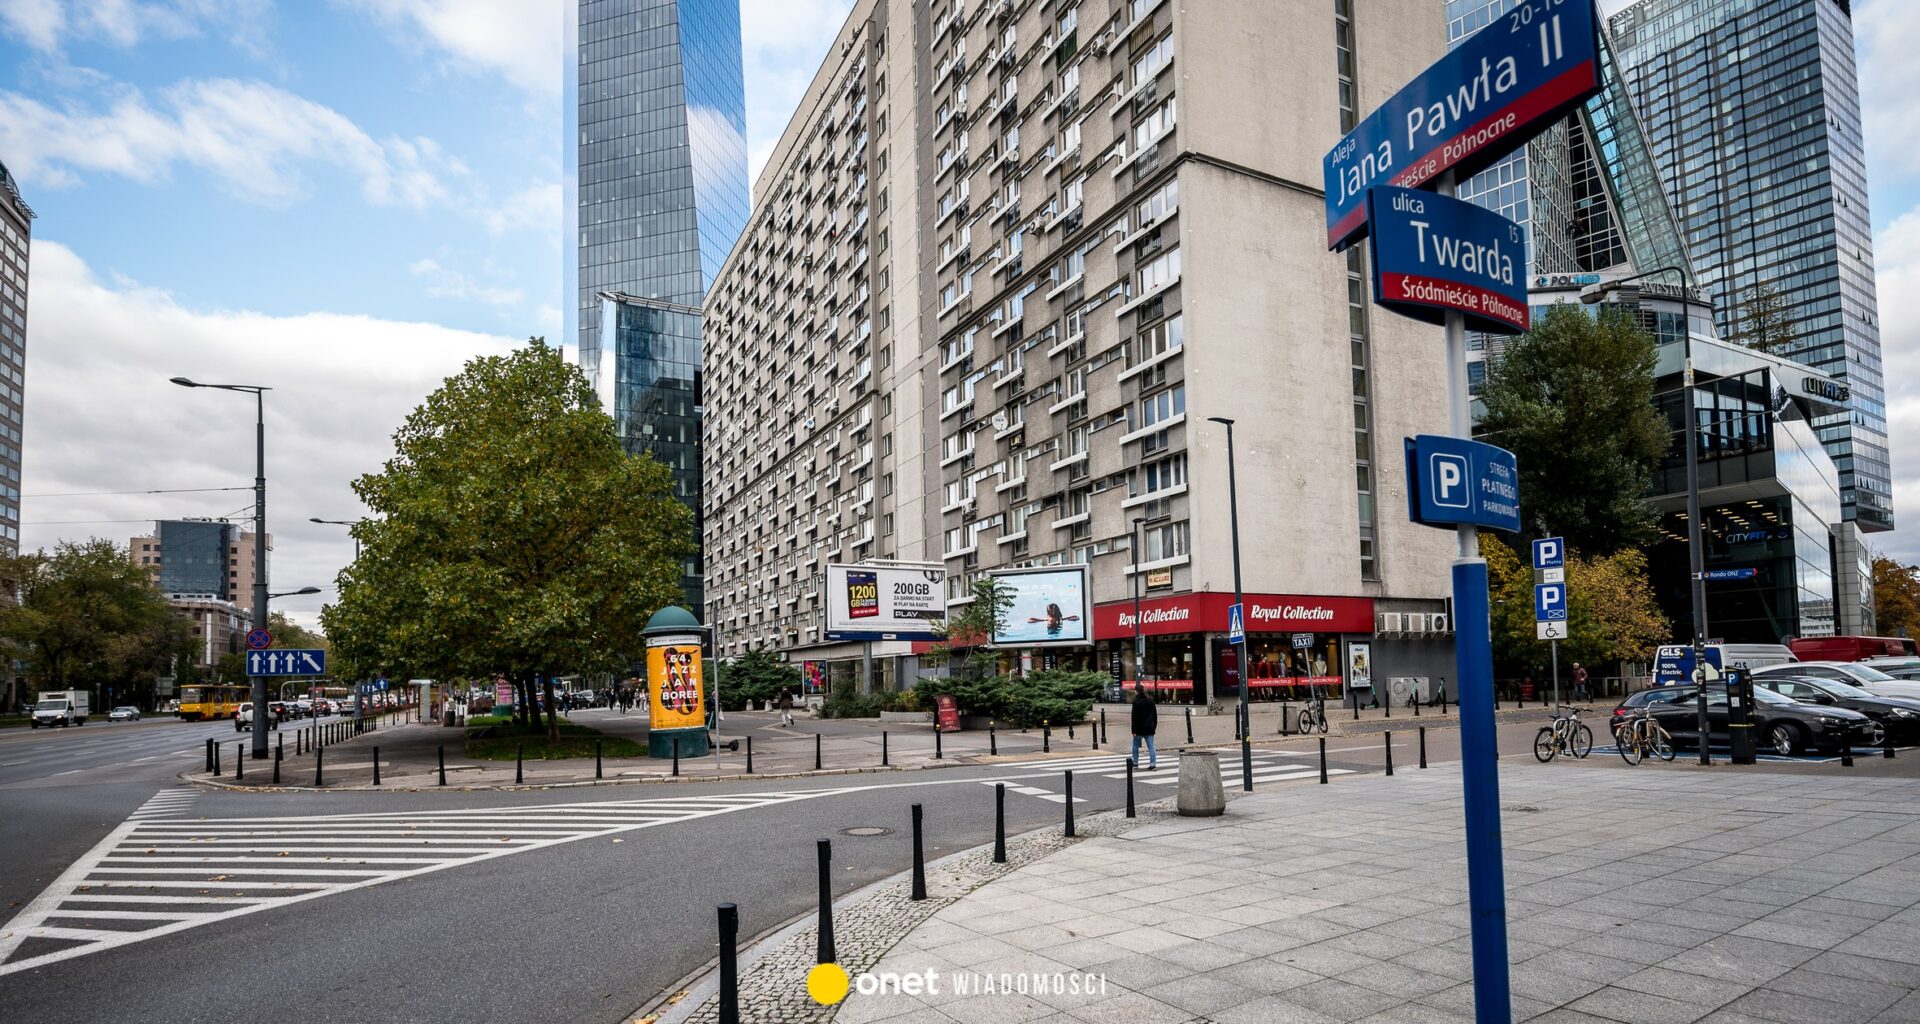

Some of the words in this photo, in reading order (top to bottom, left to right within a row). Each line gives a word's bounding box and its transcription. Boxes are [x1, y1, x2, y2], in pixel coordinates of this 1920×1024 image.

[1510, 0, 1564, 34] 20-1
[1338, 139, 1392, 207] Jana
[1407, 55, 1518, 152] Pawła
[1539, 14, 1563, 68] II
[1443, 112, 1516, 165] Północne
[1332, 138, 1356, 168] Aleja
[1392, 192, 1425, 214] ulica
[1508, 225, 1519, 244] 15
[1410, 220, 1513, 286] Twarda
[1551, 273, 1600, 286] POLMED
[1641, 281, 1702, 300] WESTWNG
[1402, 275, 1478, 309] Śródmieście
[1482, 293, 1523, 324] Północne
[1490, 461, 1510, 478] STREFA
[1482, 478, 1516, 500] PŁATNEGO
[1726, 531, 1767, 543] CITYFIT
[850, 585, 876, 599] 1200
[894, 583, 913, 595] 200
[915, 584, 929, 595] GB
[851, 600, 860, 608] GB
[1144, 606, 1189, 624] Collection
[1251, 605, 1280, 622] Royal
[1283, 606, 1334, 620] Collection
[1293, 638, 1310, 647] TAXI
[662, 665, 697, 675] JAZZ
[662, 678, 697, 688] JAM
[662, 690, 698, 700] BOREE
